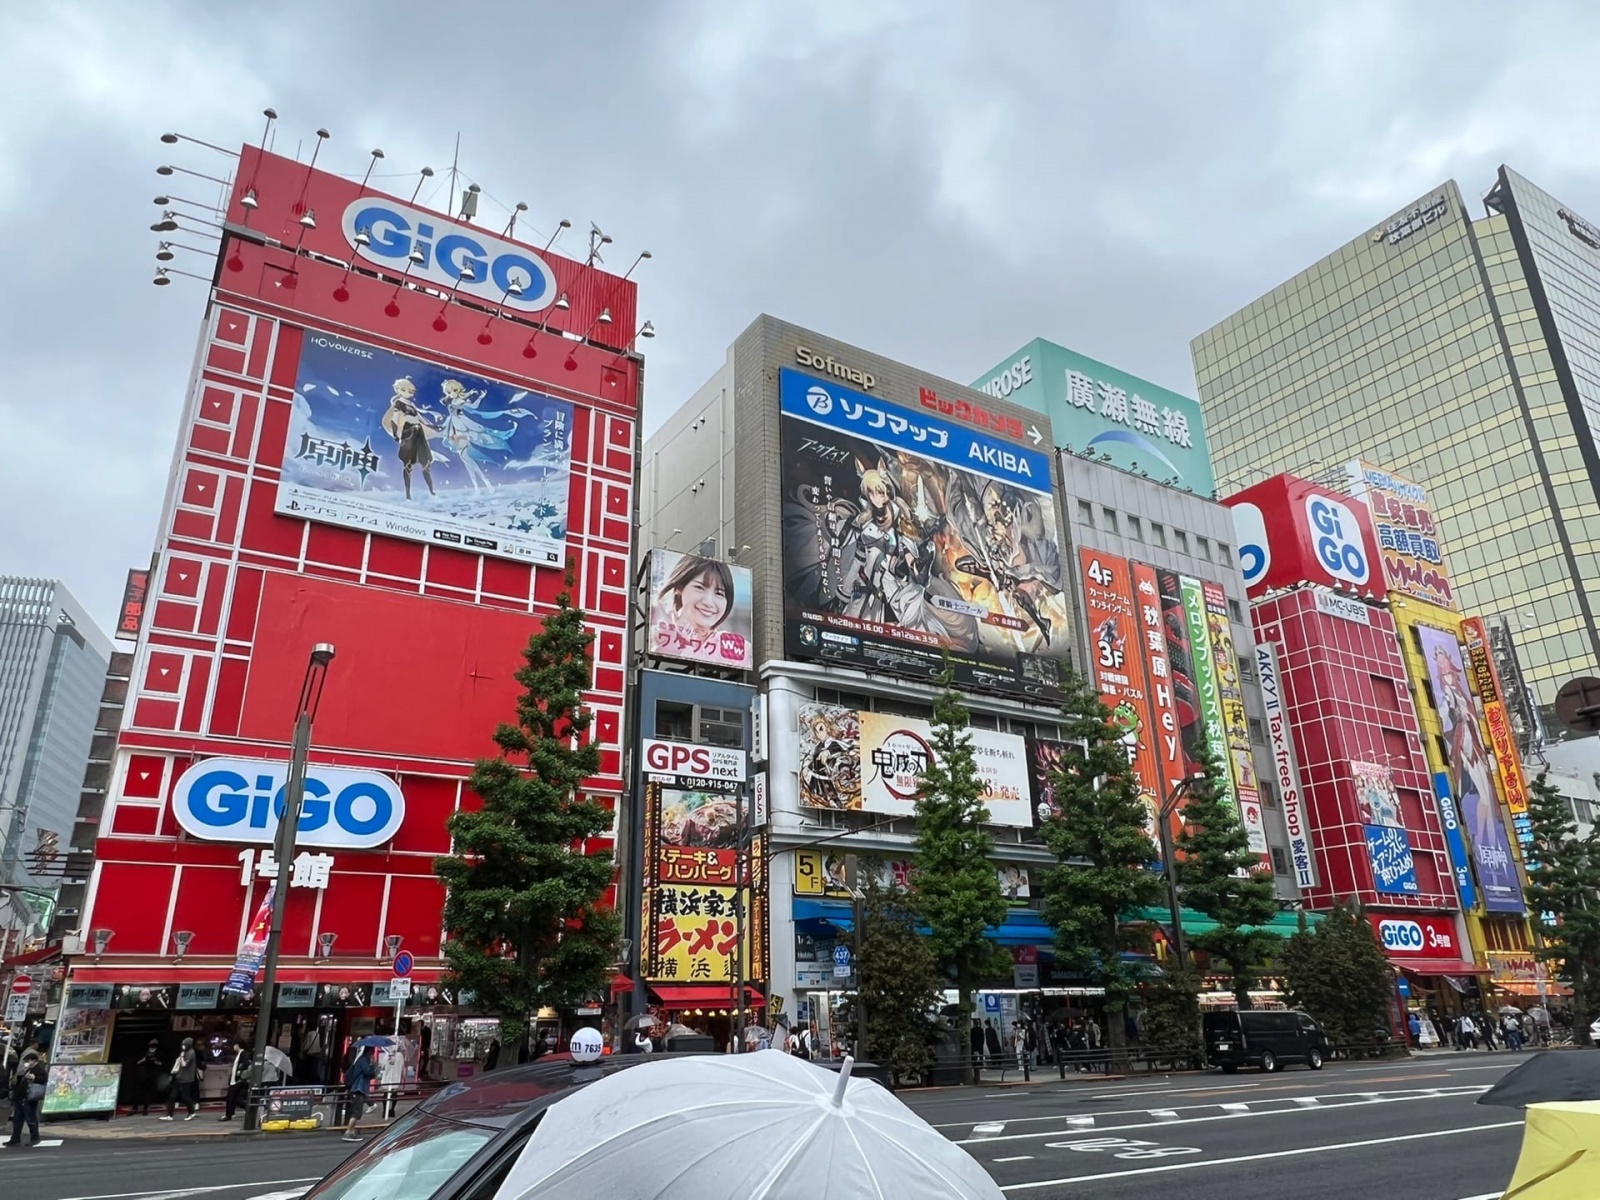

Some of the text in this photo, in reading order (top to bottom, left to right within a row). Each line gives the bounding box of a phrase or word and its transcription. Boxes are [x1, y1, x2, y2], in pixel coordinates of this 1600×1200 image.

[354, 207, 546, 301] GiGO
[796, 346, 876, 391] Sofmap
[840, 398, 949, 448] ソフマップ
[1065, 369, 1193, 449] 廣瀬無線
[968, 441, 1032, 478] AKIBA
[304, 504, 427, 537] PS5 PS4 Windows
[1376, 523, 1440, 561] 高額買取
[1087, 560, 1112, 586] 4F
[1384, 556, 1453, 601] Mulan
[1098, 639, 1124, 669] 3F
[1142, 605, 1177, 761] 秋葉原 Hey
[647, 743, 711, 775] GPS
[1256, 648, 1278, 695] AKKY
[1269, 712, 1293, 788] Tax-free
[1283, 790, 1301, 837] Shop
[712, 766, 739, 778] next
[187, 770, 394, 836] GiGO
[1441, 797, 1457, 830] GiGO
[237, 848, 335, 890] 1号館
[666, 863, 733, 882] ハンバーグ
[658, 917, 747, 956] ラーメン
[1381, 924, 1423, 947] GiGO
[1426, 925, 1452, 948] 3号館
[834, 951, 848, 960] 437
